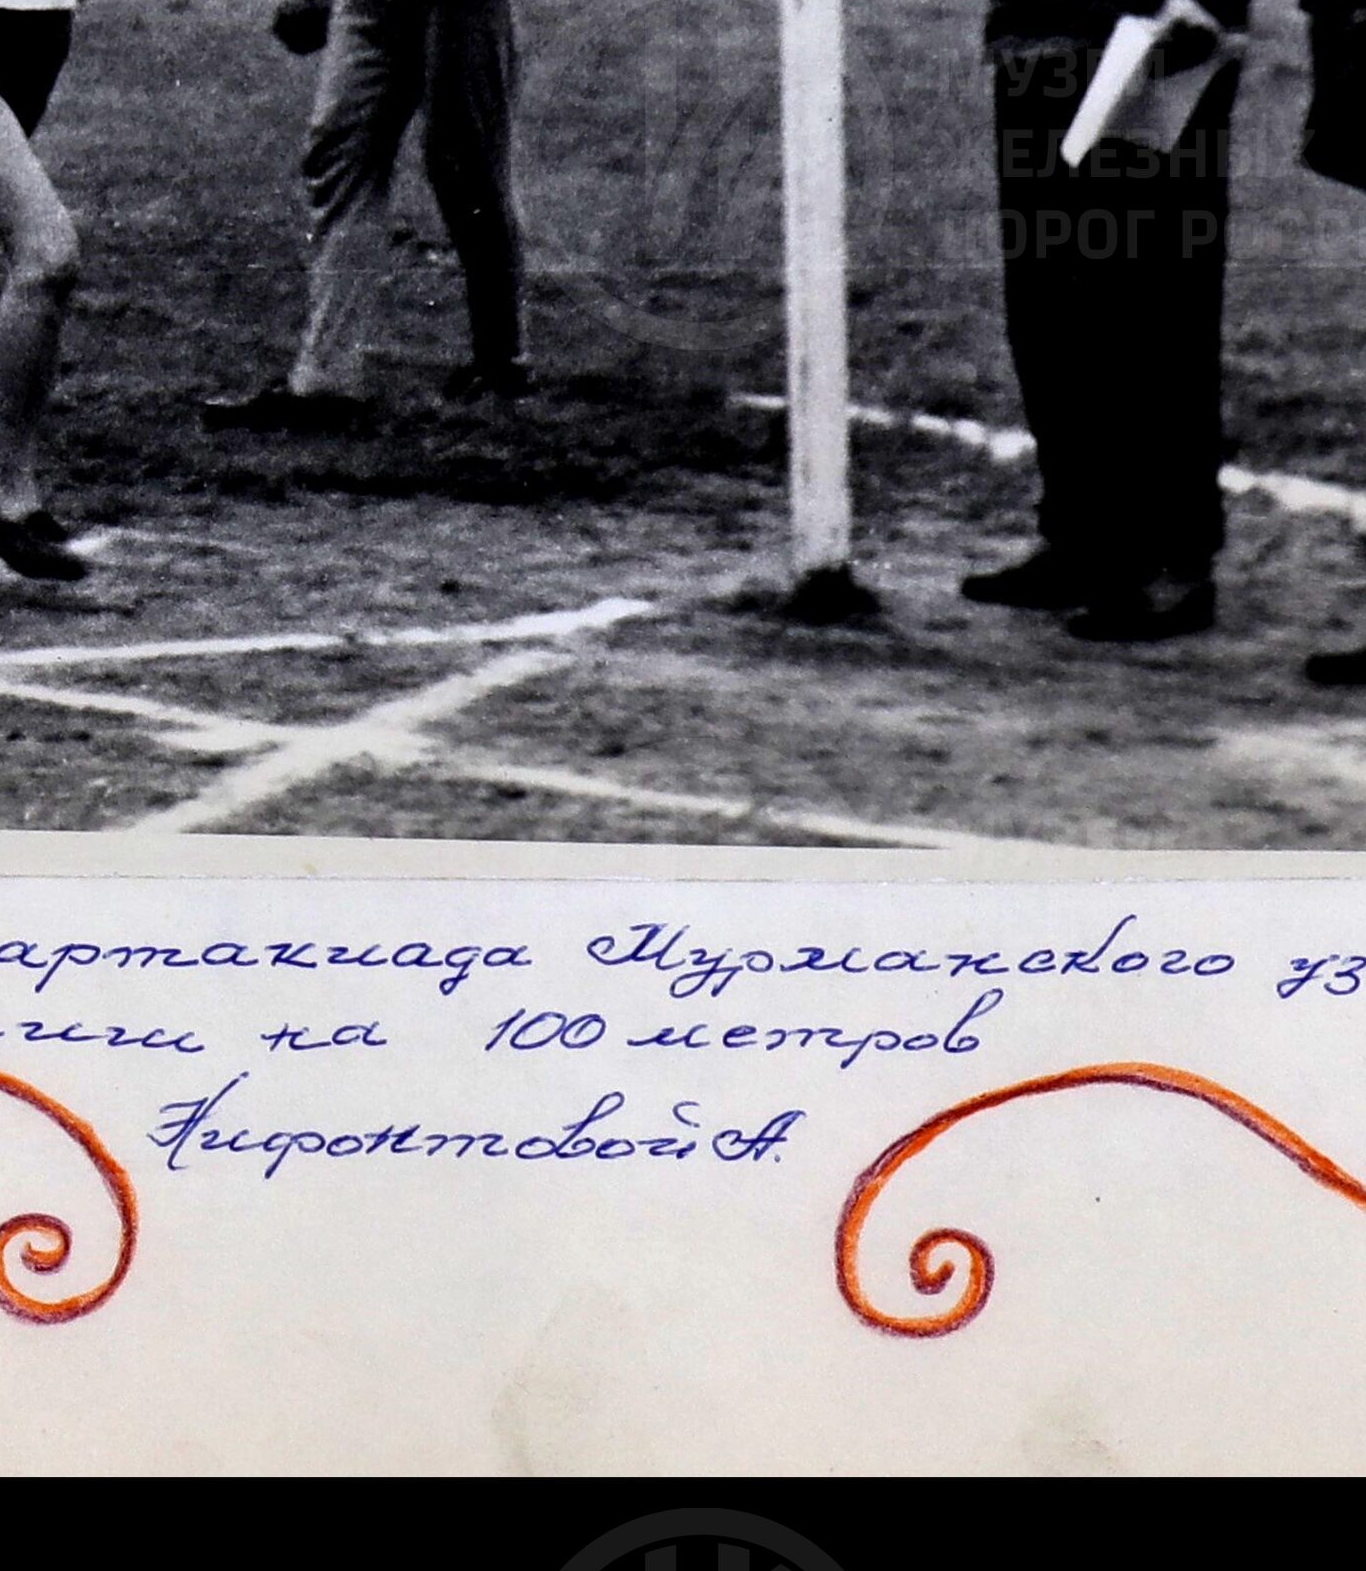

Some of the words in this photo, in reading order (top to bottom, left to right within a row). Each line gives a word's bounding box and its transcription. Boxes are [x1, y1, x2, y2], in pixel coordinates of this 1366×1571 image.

[585, 913, 1237, 1000] Мурманского
[259, 1021, 388, 1052] на
[484, 1007, 608, 1053] 100
[625, 986, 1004, 1071] метров
